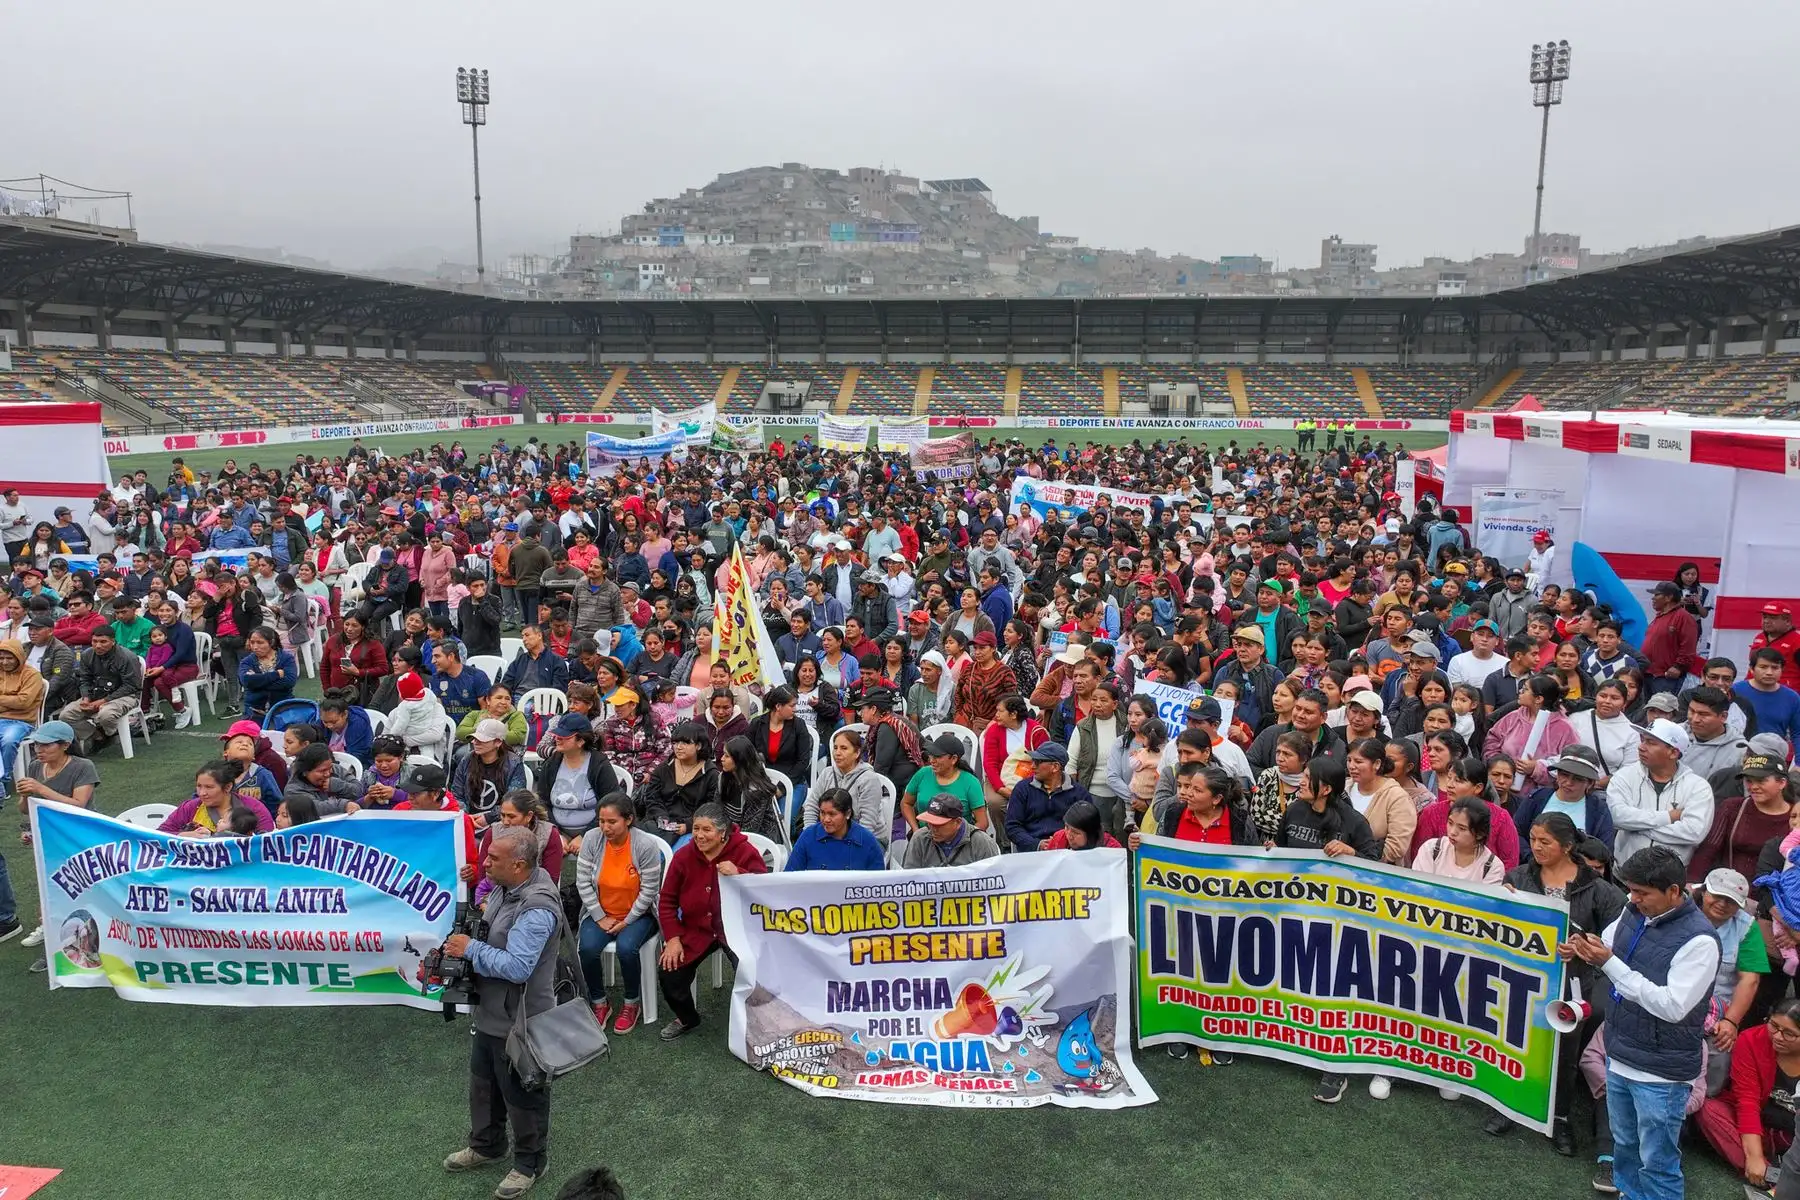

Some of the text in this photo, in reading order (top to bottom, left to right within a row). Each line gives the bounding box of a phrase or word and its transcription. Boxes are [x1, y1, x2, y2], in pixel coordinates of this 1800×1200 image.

[312, 430, 320, 438] EL
[320, 426, 350, 438] DEPORTE
[375, 423, 398, 434] AVANZA
[434, 420, 450, 430] VIDAL
[1048, 418, 1058, 426] EL
[1060, 418, 1100, 426] DEPORTE
[1135, 419, 1173, 427] AVANZA
[1196, 420, 1234, 428] FRANCO
[1236, 420, 1264, 428] VIDAL
[104, 441, 130, 454] IDAL
[1657, 438, 1682, 451] SEDAPAL
[1484, 522, 1554, 534] Vivienda Social
[52, 834, 452, 921] ESQUEMA DE AGUA Y ALCANTARILLADO
[845, 875, 1005, 900] ASOCIACIÓN DE VIVIENDA
[126, 885, 168, 912] ATE
[192, 888, 270, 913] SANTA
[275, 888, 348, 914] ANITA
[1146, 867, 1550, 956] ASOCIACIÓN DE VIVIENDA
[810, 900, 900, 936] LOMAS
[902, 898, 938, 928] DE
[940, 896, 986, 926] ATE
[108, 917, 384, 952] ASOC. DE VIVIENDAS LAS LOMAS DE ATE
[849, 928, 1006, 966] PRESENTE
[134, 960, 354, 988] PRESENTE
[1150, 904, 1542, 1050] LIVOMARKET
[826, 977, 954, 1013] MARCHA
[868, 1017, 924, 1036] POR EL
[1158, 985, 1524, 1080] FUNDADO EL 19 DE JULIO DEL 2010
[754, 1030, 844, 1056] QUE SE EJECUTE
[776, 1043, 836, 1061] PROYECTO
[890, 1040, 992, 1072] AGUA
[1202, 1016, 1474, 1078] CON PARTIDA 12548486
[858, 1070, 928, 1087] LOMAS
